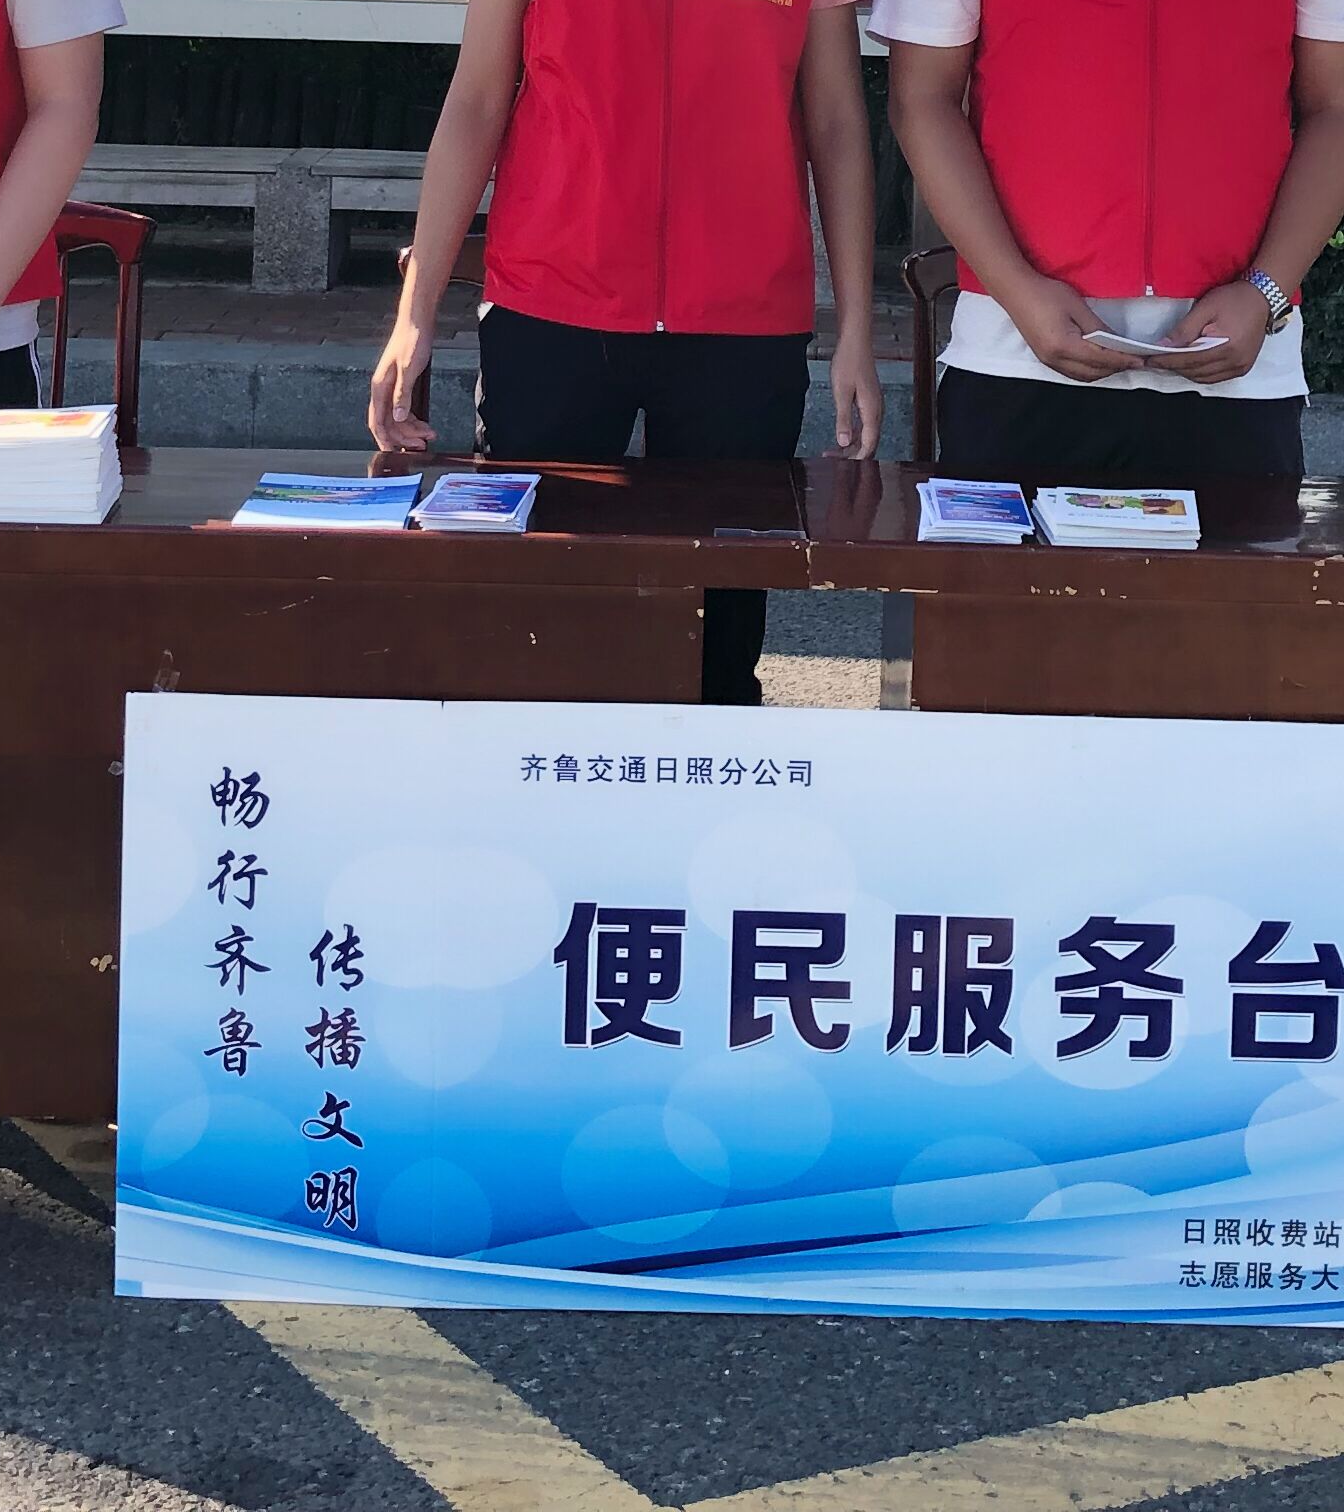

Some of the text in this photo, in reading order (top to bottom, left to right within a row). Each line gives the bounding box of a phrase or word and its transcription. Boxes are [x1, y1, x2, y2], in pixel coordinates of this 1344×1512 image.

[520, 753, 813, 787] 齐鲁交通日照分公司
[203, 766, 272, 1077] 畅行齐鲁
[301, 923, 367, 1233] 传播文明
[1183, 1218, 1343, 1248] 日照收费站
